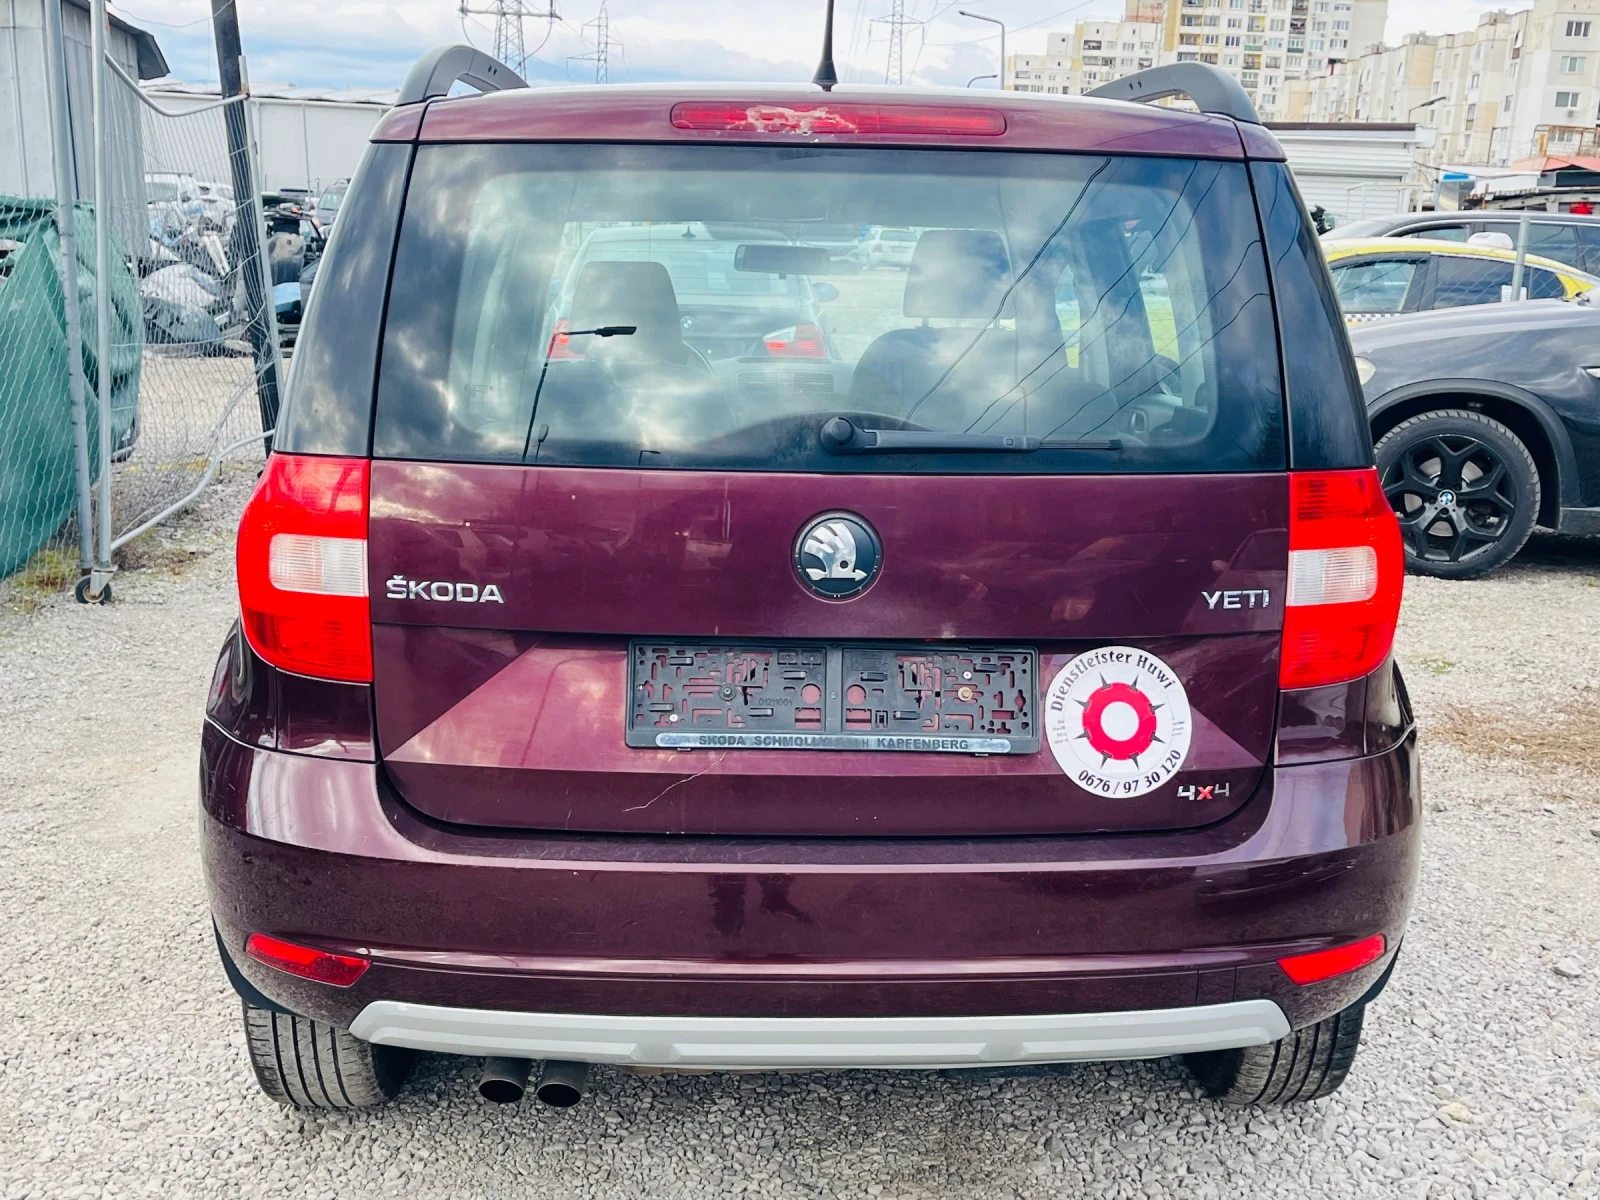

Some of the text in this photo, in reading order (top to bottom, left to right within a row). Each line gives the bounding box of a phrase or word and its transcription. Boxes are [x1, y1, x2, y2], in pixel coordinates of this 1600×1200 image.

[386, 574, 505, 604] ŠKODA
[1201, 589, 1270, 609] YETI
[1050, 650, 1176, 712] Dienstleister Huwi
[698, 735, 746, 747] SKODA
[876, 737, 969, 750] KAPFENBERG
[1078, 749, 1181, 795] 0676 / 97 30 120
